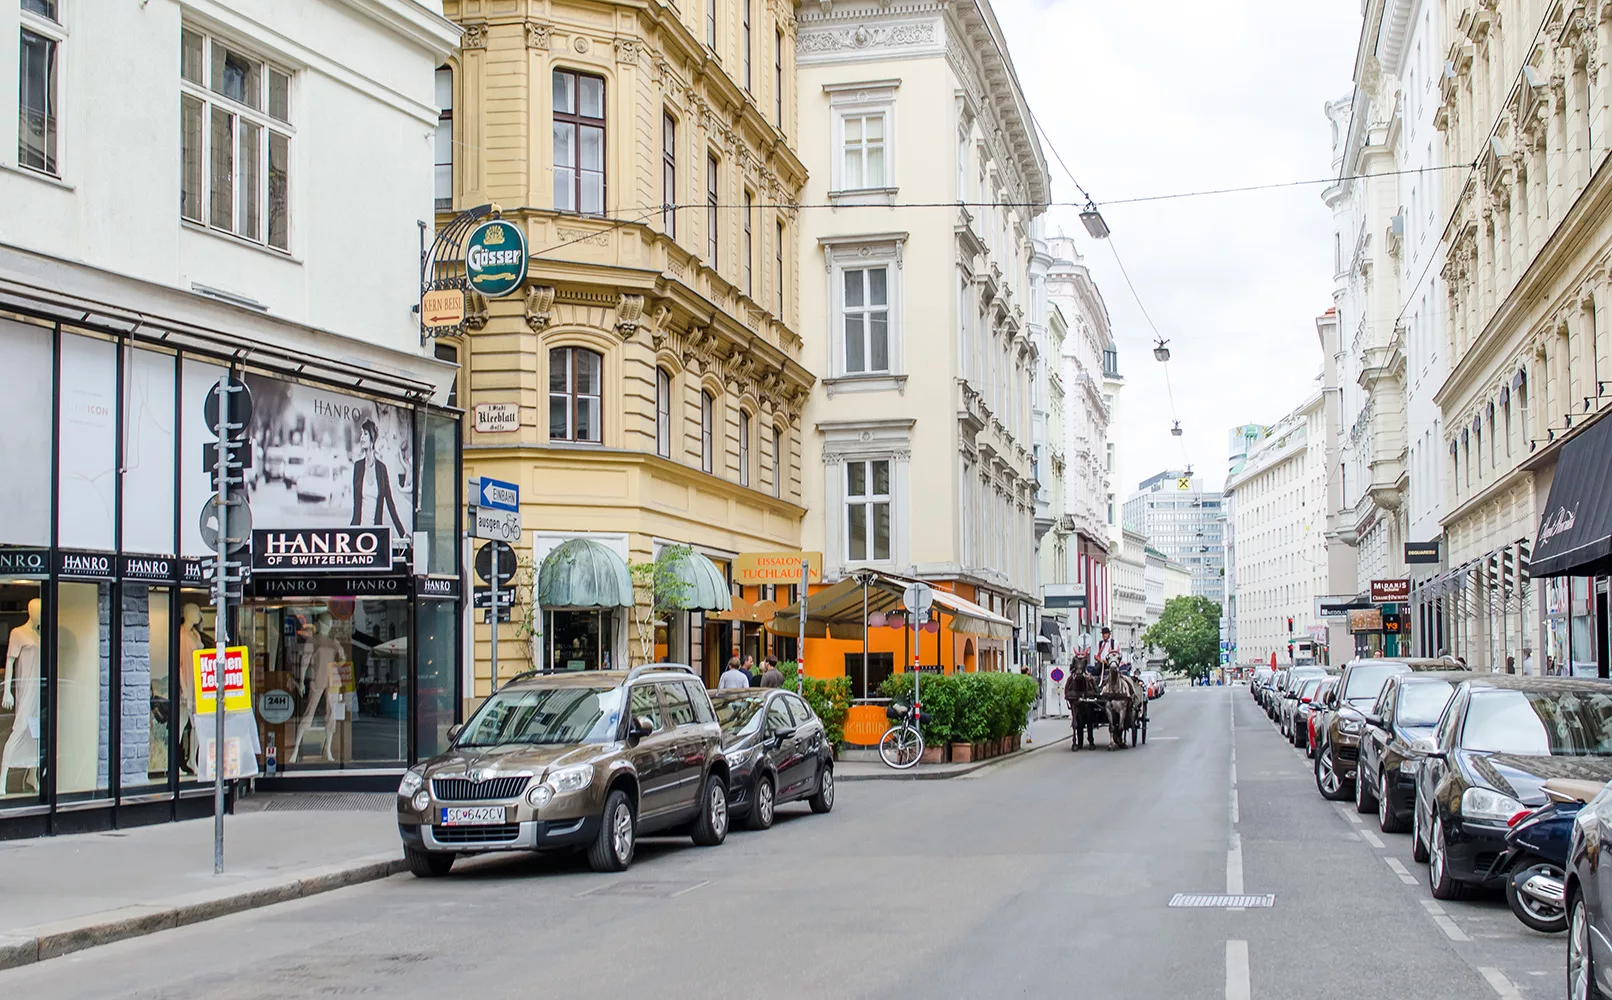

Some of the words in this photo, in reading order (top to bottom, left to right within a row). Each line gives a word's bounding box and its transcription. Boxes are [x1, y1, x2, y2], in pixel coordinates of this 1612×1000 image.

[468, 245, 521, 272] Gösser
[424, 299, 443, 312] KERN
[445, 297, 463, 310] BEISL
[87, 405, 109, 416] ICON
[314, 399, 361, 421] HANRO
[478, 411, 515, 423] Kleeblatt
[493, 487, 516, 504] EINBAHN
[267, 532, 379, 554] HANRO
[64, 555, 109, 570] HANRO
[127, 559, 169, 573] HANRO
[267, 556, 283, 565] OF
[291, 555, 374, 565] SWITZERLAND
[757, 558, 801, 566] EISSALON
[742, 568, 818, 579] TUCHLAUBN
[266, 580, 317, 591] HANRO
[346, 579, 397, 591] HANRO
[424, 579, 450, 591] HANRO
[268, 697, 286, 705] 24H
[468, 807, 504, 821] 642CV
